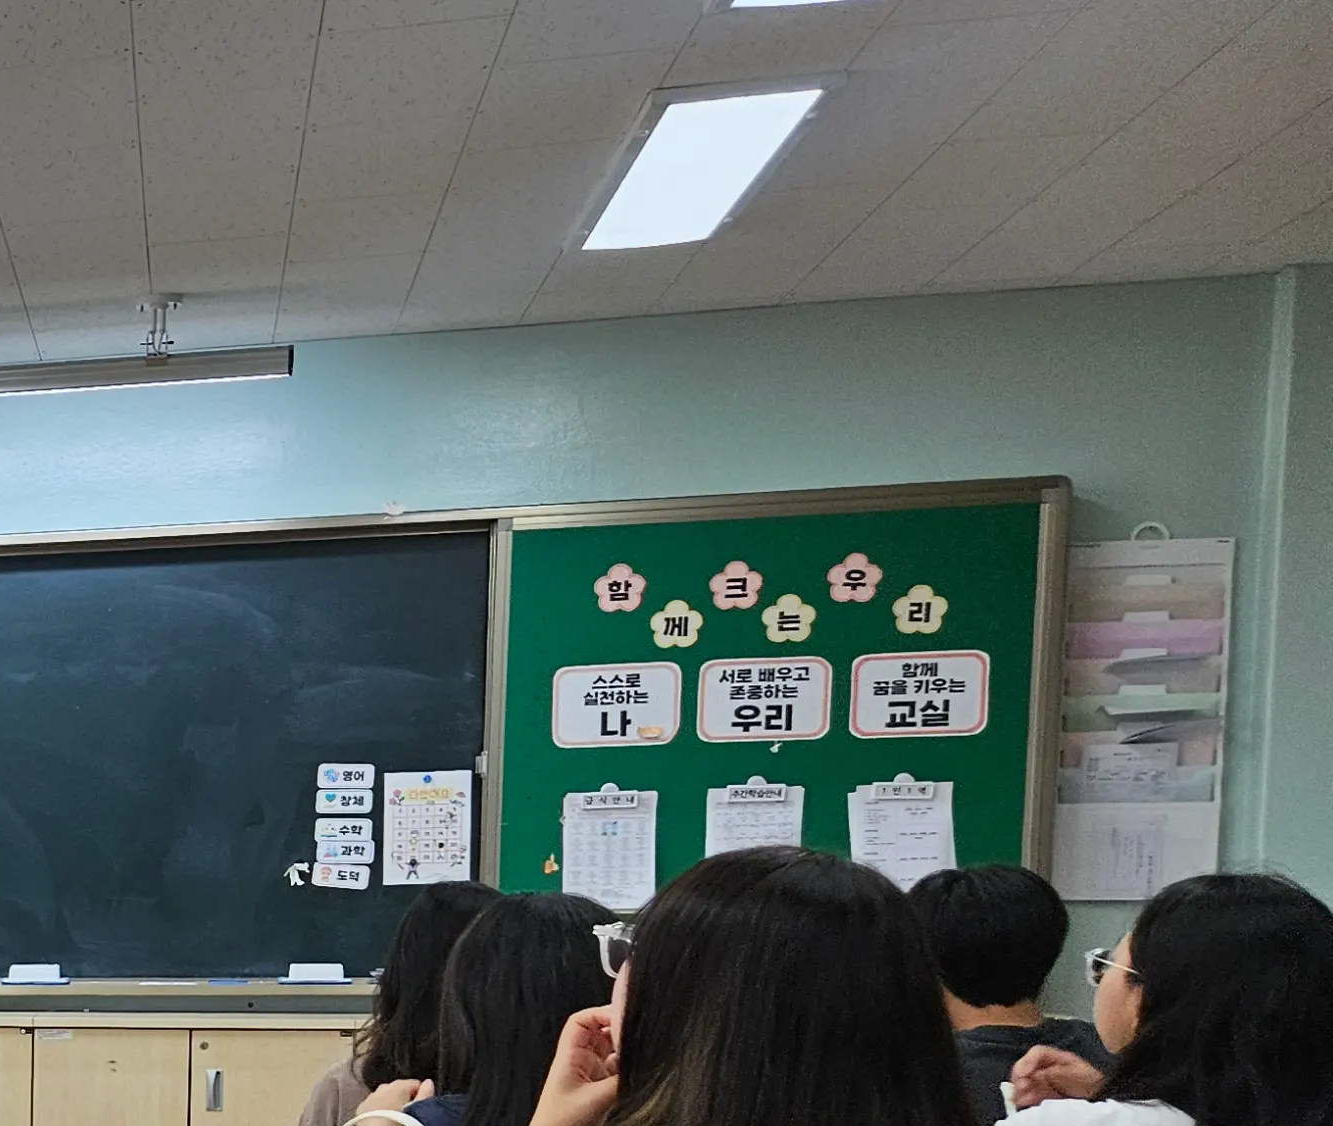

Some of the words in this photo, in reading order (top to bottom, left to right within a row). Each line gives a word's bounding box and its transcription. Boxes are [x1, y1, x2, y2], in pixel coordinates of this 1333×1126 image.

[719, 668, 752, 684] 서로
[758, 667, 810, 683] 배우고
[901, 662, 939, 678] 함께
[591, 673, 642, 690] 스스로
[873, 679, 909, 696] 꿈을
[914, 678, 966, 694] 키우는
[583, 690, 649, 706] 실천하는
[729, 684, 799, 700] 존중하는
[731, 704, 794, 733] 우리
[885, 699, 951, 729] 교실
[600, 710, 632, 737] 나
[342, 770, 365, 782] 영어
[340, 795, 364, 807] 창체
[339, 825, 363, 836] 수학
[341, 845, 365, 857] 과학
[336, 869, 360, 882] 도덕
